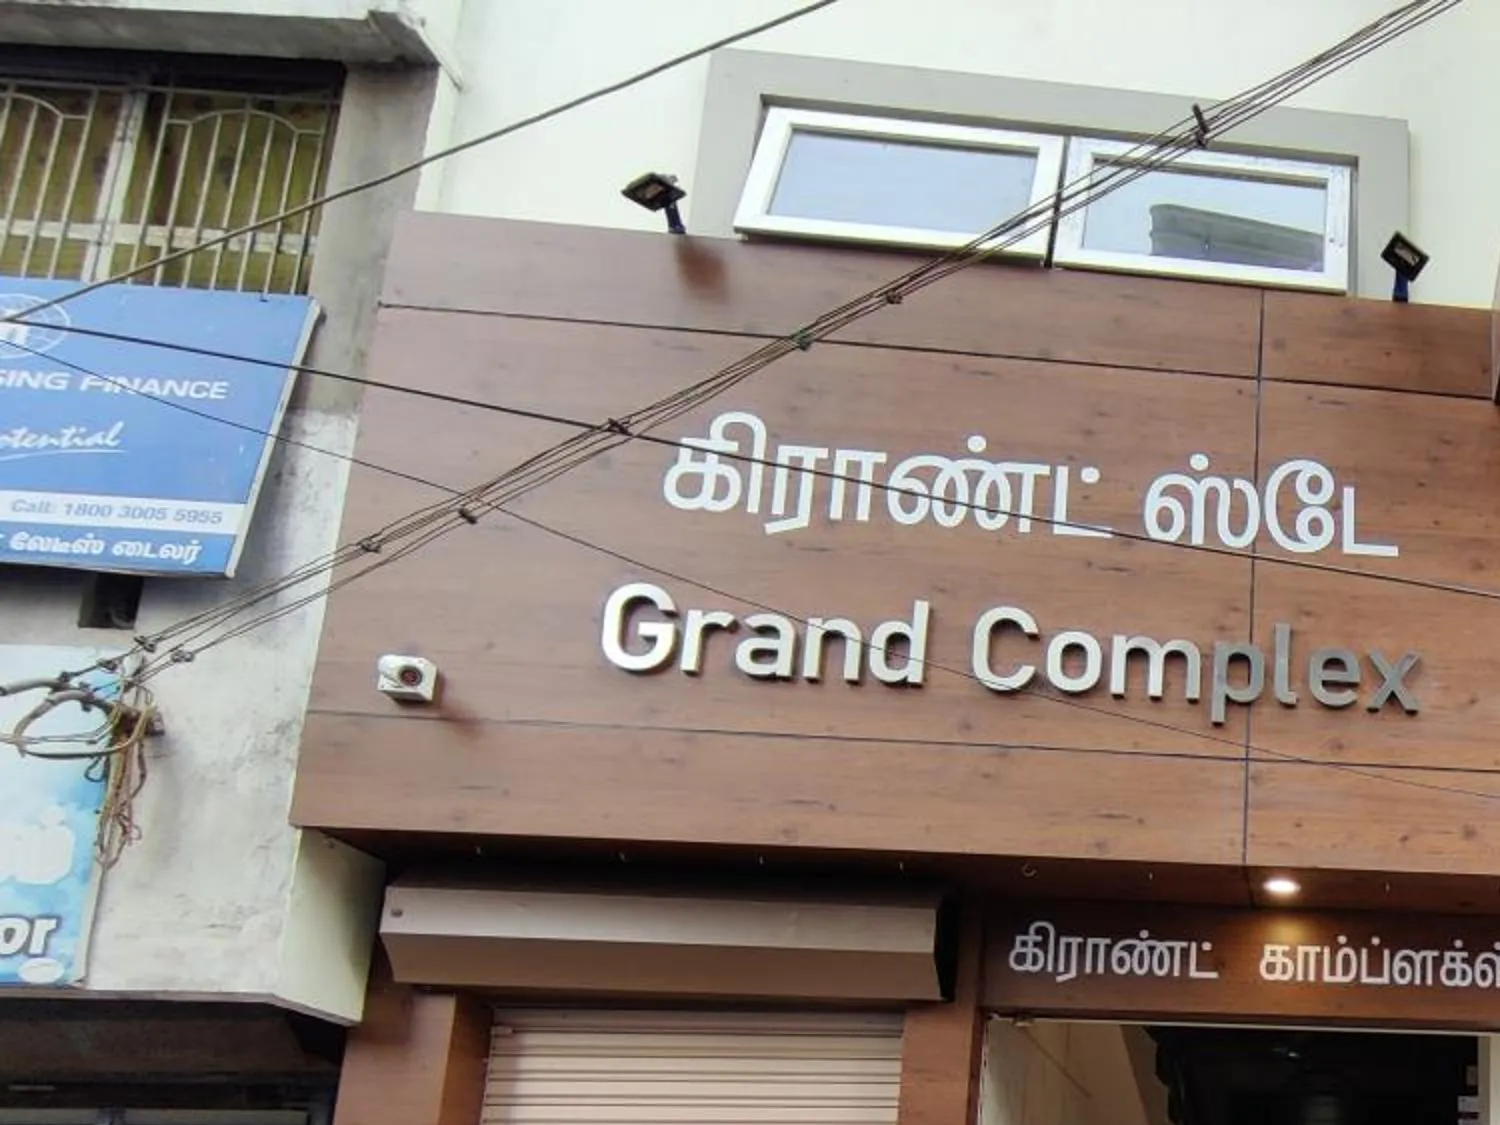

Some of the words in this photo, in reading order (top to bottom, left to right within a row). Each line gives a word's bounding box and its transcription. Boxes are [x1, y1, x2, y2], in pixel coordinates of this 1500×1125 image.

[80, 375, 230, 400] FINANCE
[664, 412, 1113, 538] கிராண்ட்
[1144, 454, 1398, 557] ஸ்டே
[63, 502, 112, 517] 1800
[117, 505, 167, 521] 3005
[113, 539, 202, 565] டைலர்
[600, 583, 931, 688] Grand
[971, 606, 1422, 727] Complex
[1008, 920, 1219, 983] கிராண்ட்
